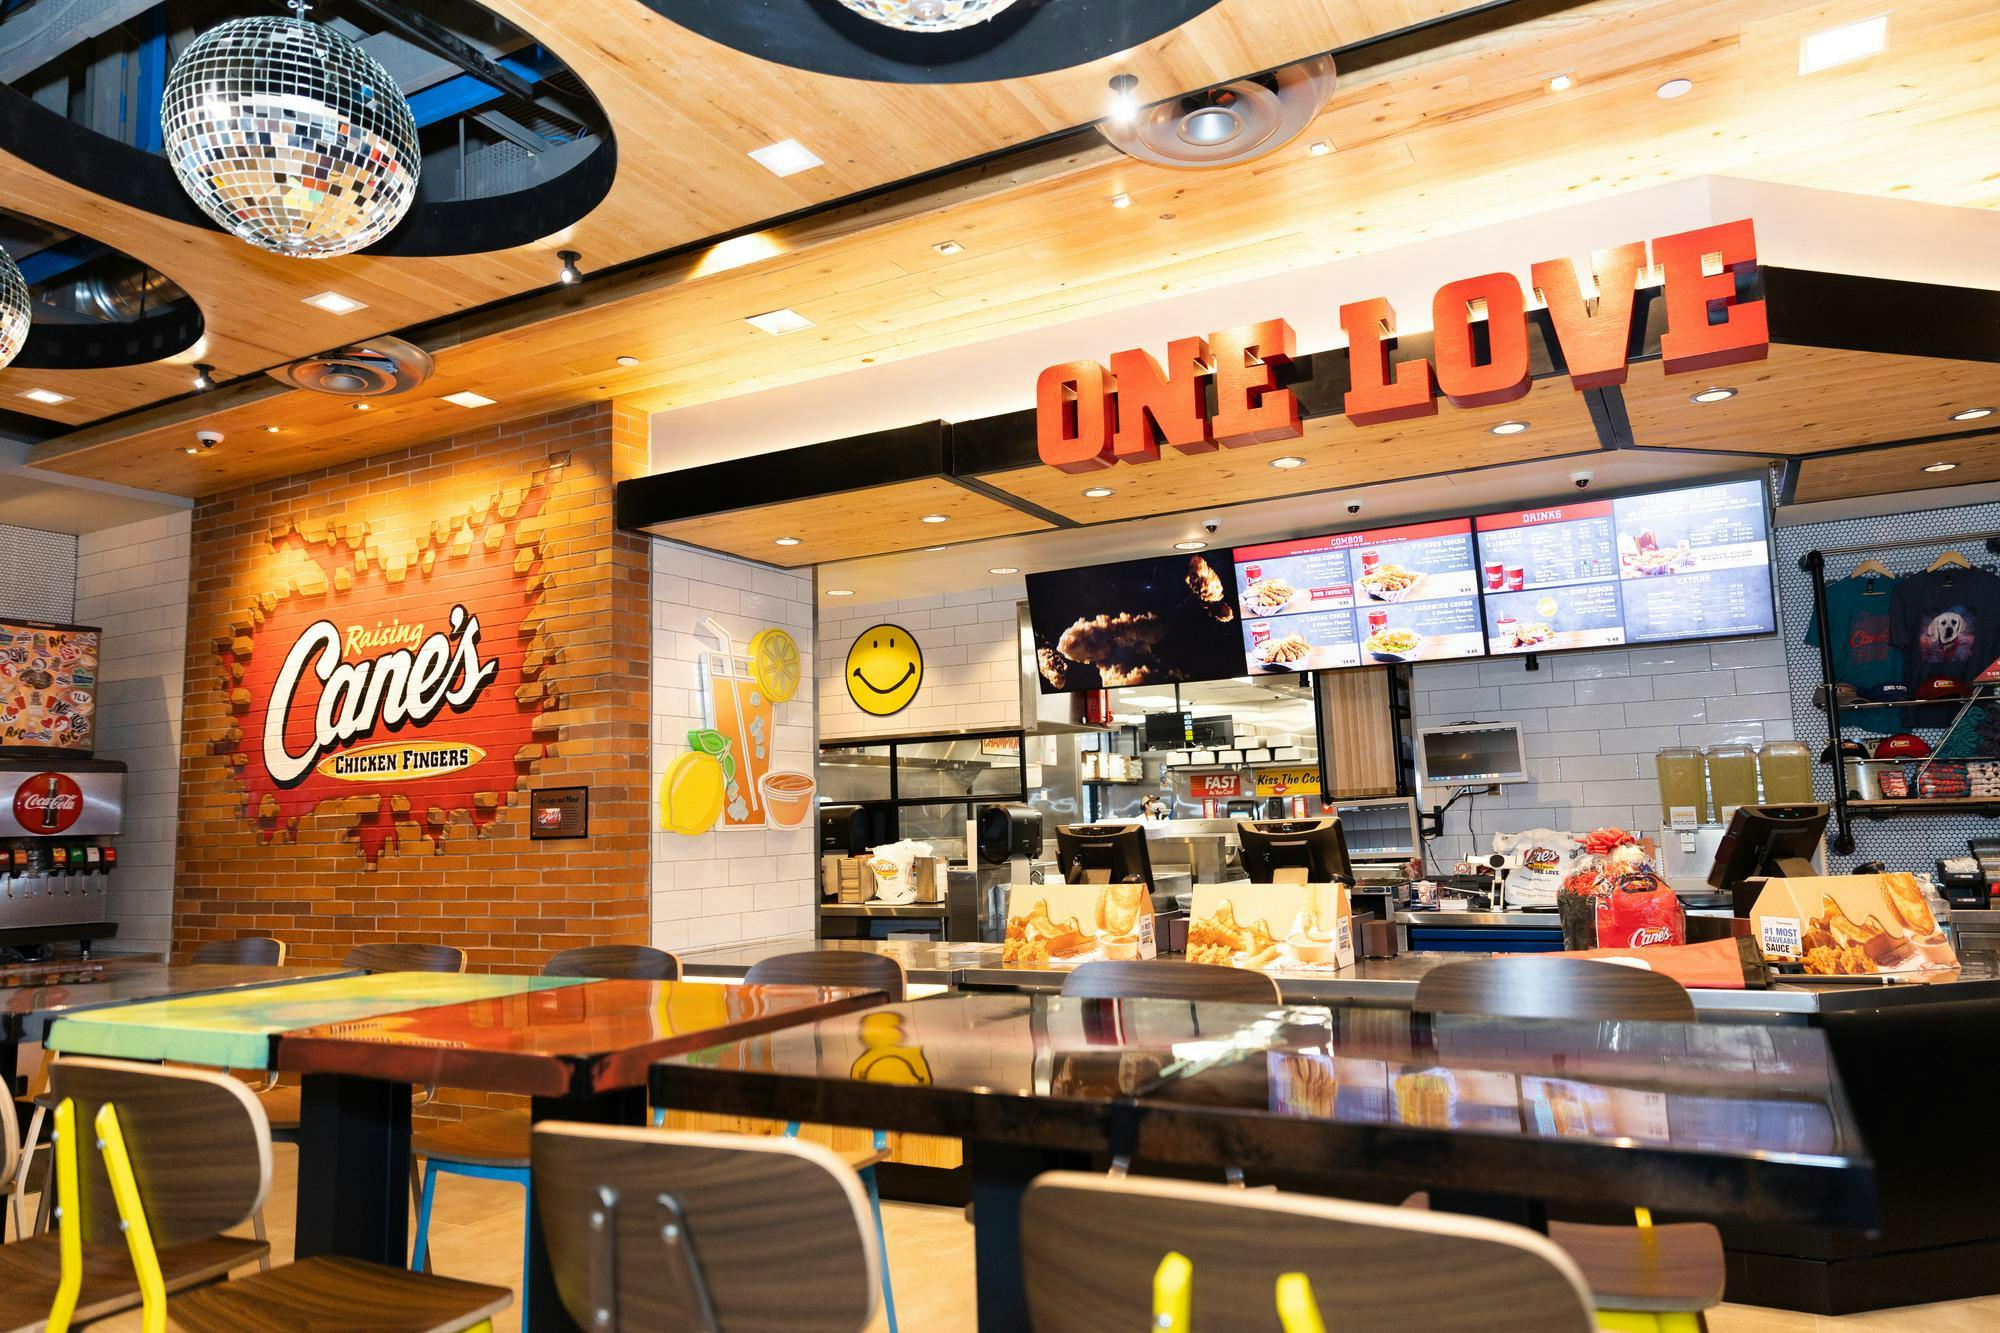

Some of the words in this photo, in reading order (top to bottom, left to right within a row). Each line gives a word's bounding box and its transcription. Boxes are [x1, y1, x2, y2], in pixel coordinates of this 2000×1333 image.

[1036, 317, 1303, 474] ONE
[1339, 217, 1769, 427] LOVE
[1522, 509, 1562, 523] DRINKS
[1331, 535, 1364, 546] COMBOS
[343, 619, 425, 657] Raising
[263, 604, 499, 789] Cane's
[335, 754, 397, 774] CHICKEN
[402, 748, 469, 771] FINGERS
[1205, 775, 1237, 789] FAST
[1257, 773, 1279, 786] Kiss
[1282, 773, 1299, 785] The
[24, 793, 80, 810] Coca-Cola
[1630, 926, 1672, 949] Cane's
[1764, 927, 1773, 936] #1
[1776, 927, 1798, 937] MOST
[1764, 935, 1798, 945] CRAVEABLE
[1766, 943, 1790, 953] SAUCE
